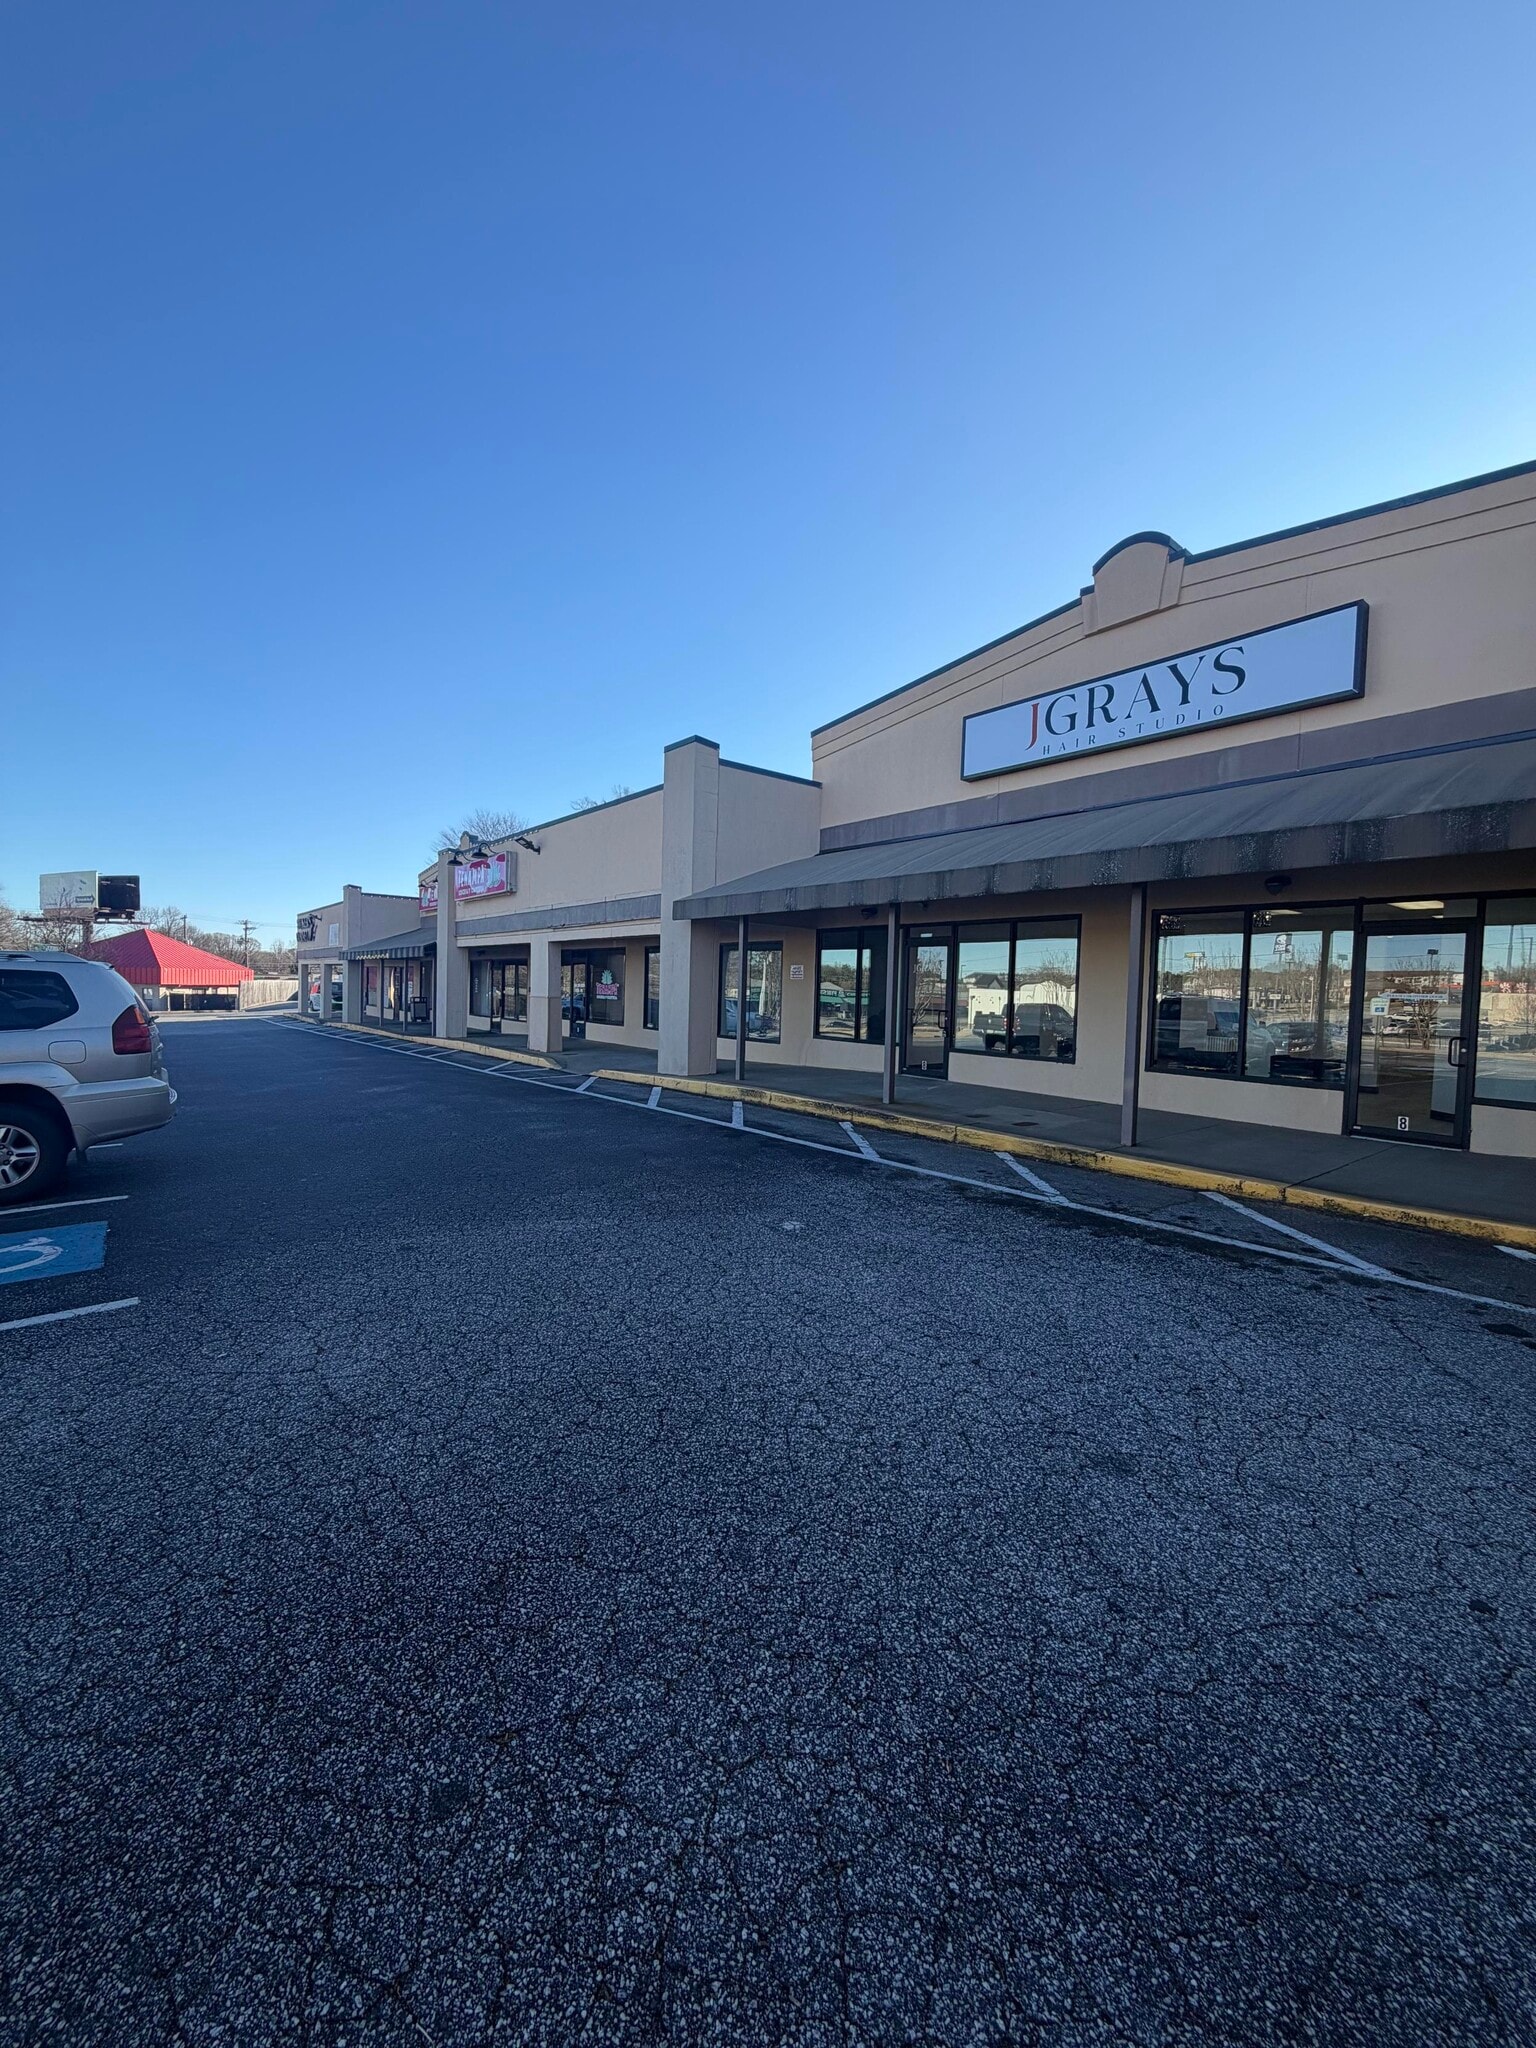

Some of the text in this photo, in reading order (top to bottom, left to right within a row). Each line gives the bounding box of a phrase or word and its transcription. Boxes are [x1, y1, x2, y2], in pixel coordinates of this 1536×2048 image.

[1025, 646, 1246, 750] JGRAYS
[1042, 704, 1224, 755] HAIR STUDIO
[1399, 1117, 1407, 1130] 8
